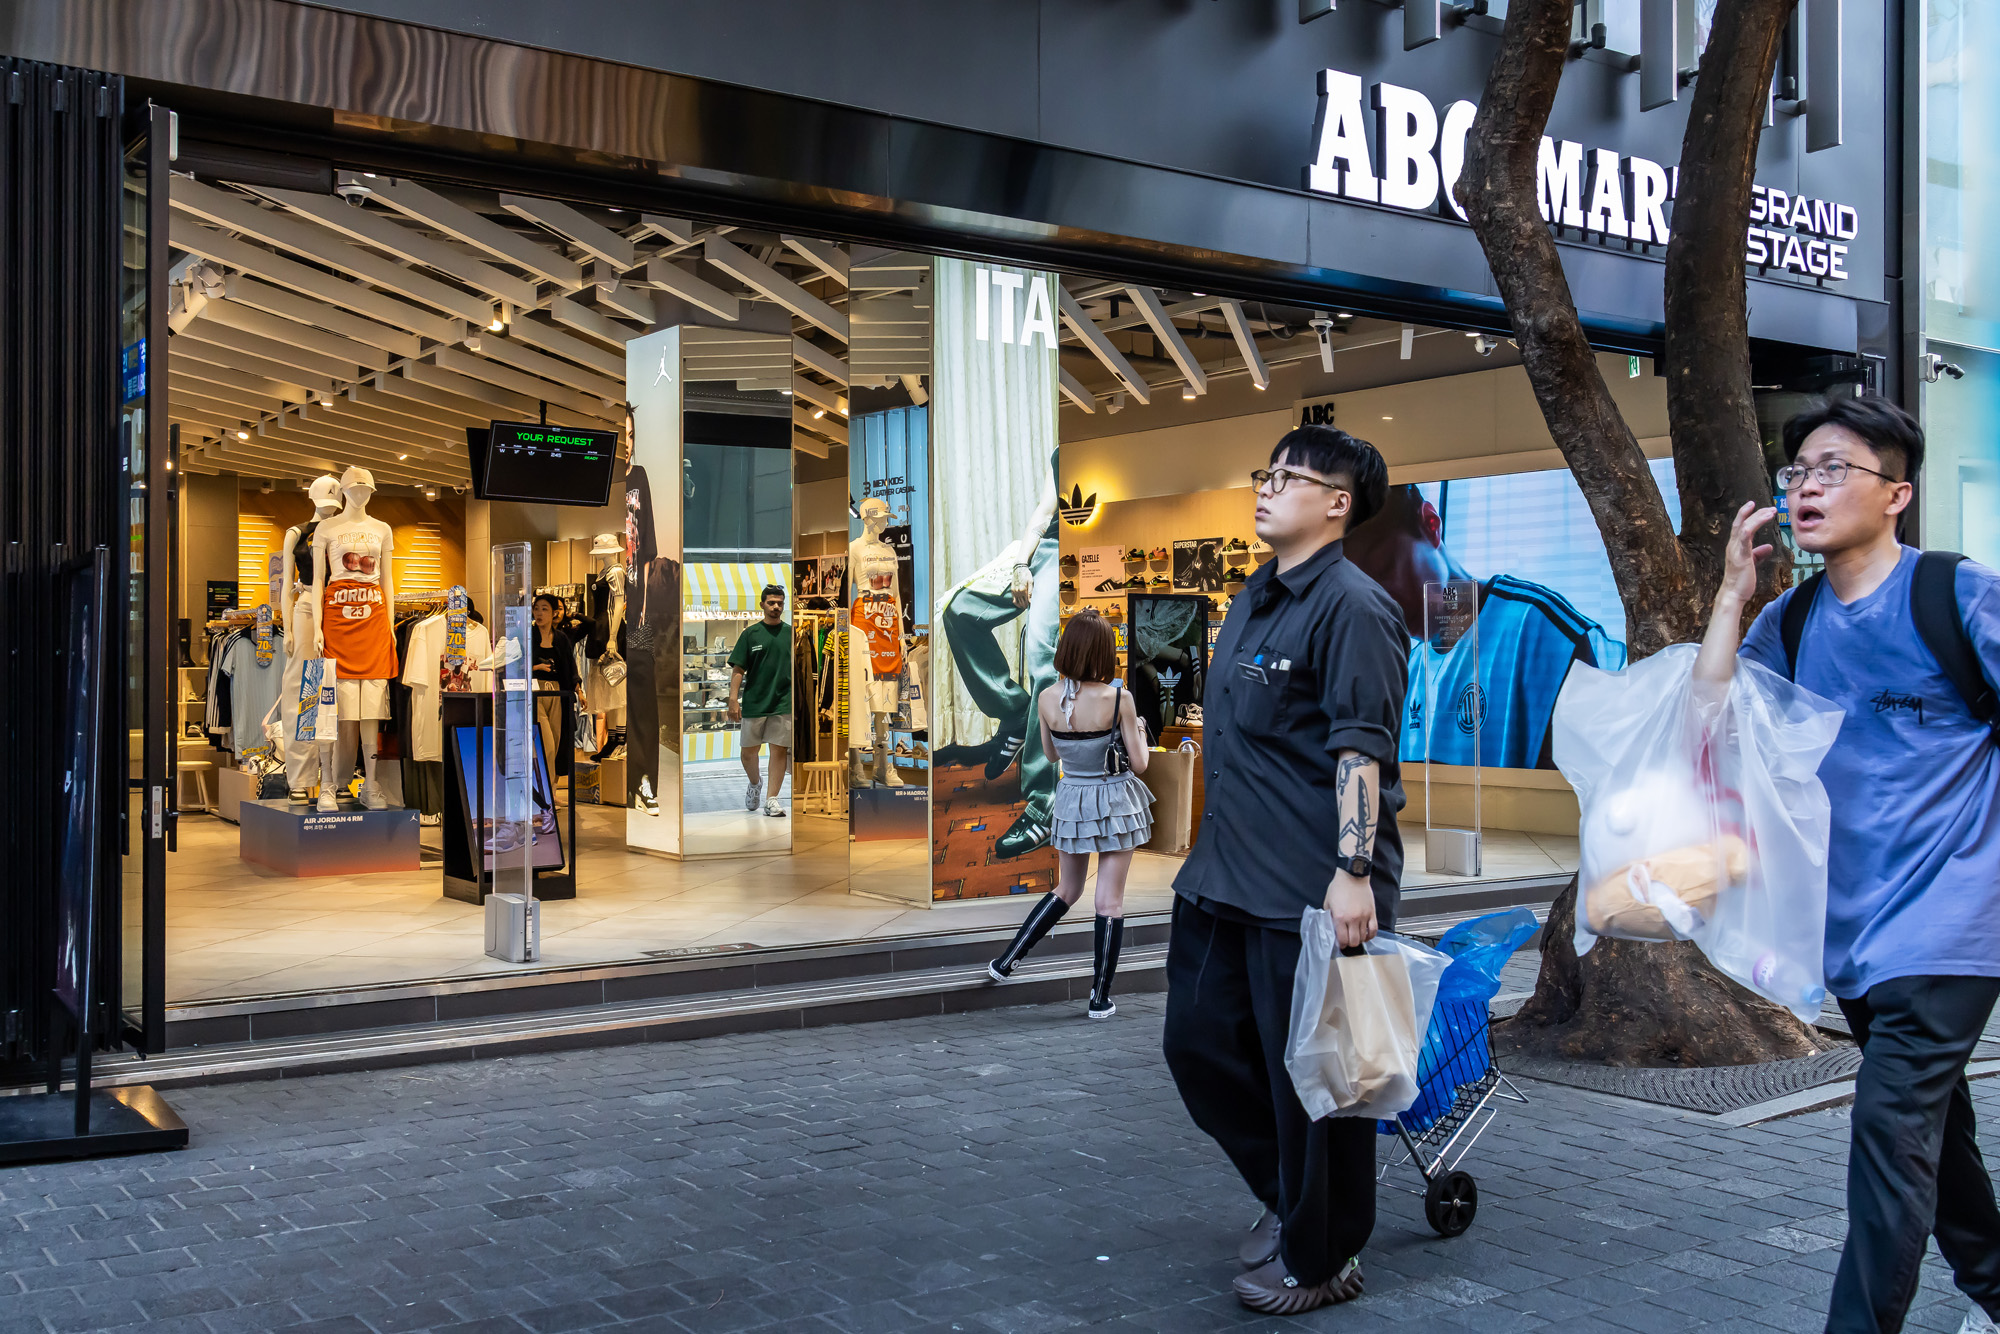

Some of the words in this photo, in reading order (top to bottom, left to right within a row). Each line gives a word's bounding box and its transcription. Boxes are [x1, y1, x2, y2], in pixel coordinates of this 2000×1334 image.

[1536, 134, 1679, 245] MAR
[1749, 184, 1859, 240] GRAND
[1746, 226, 1848, 280] STAGE
[976, 267, 1058, 350] ITA
[1301, 402, 1335, 426] ABC
[516, 432, 544, 442] YOUR
[547, 434, 594, 447] REQUEST
[889, 476, 905, 486] KIDS
[1173, 541, 1198, 549] SUPERSTAR
[1081, 554, 1100, 563] GAZELLE
[328, 587, 383, 605] JORDAN
[350, 607, 365, 617] 23
